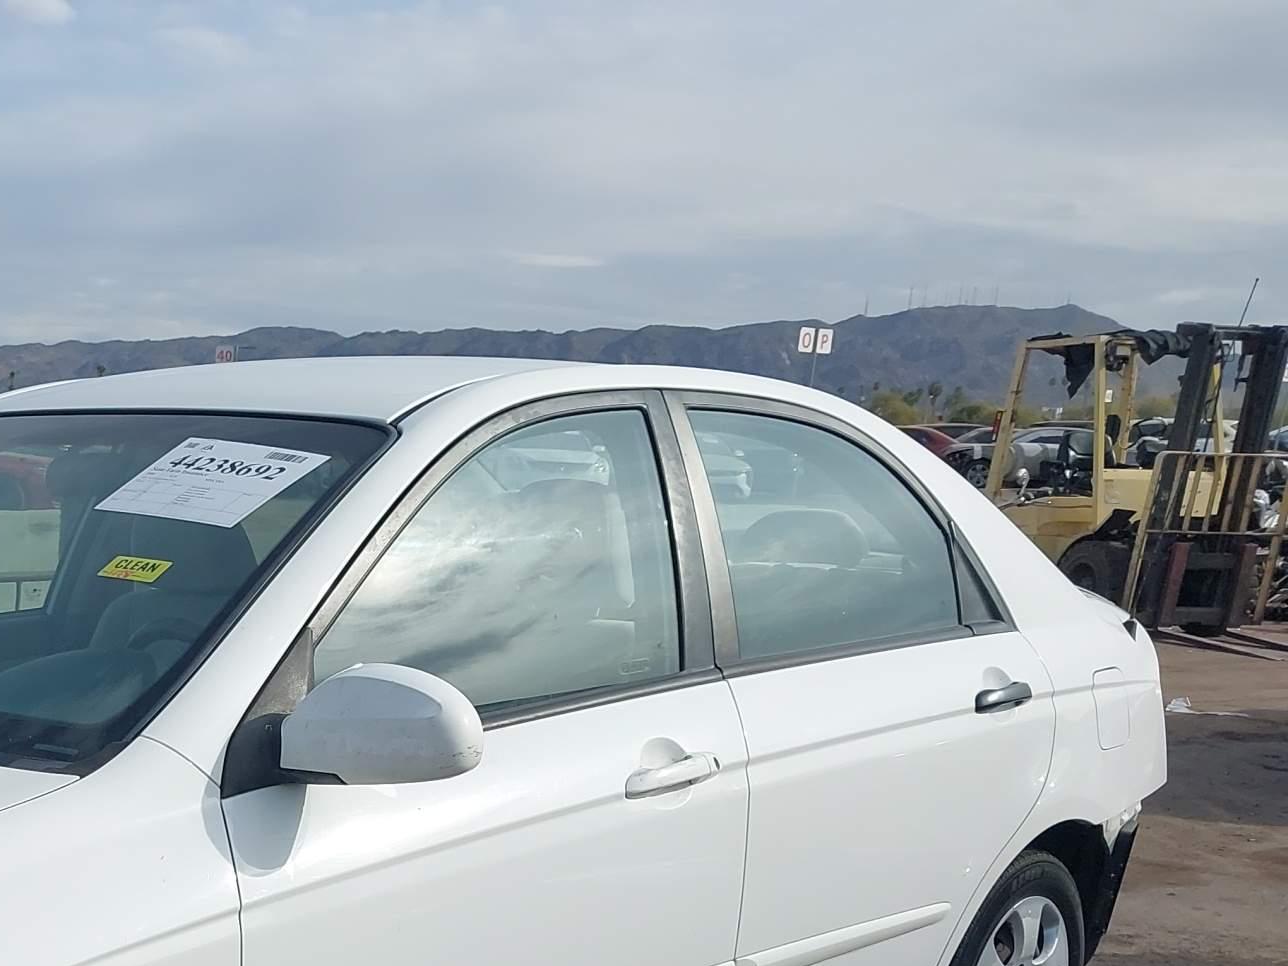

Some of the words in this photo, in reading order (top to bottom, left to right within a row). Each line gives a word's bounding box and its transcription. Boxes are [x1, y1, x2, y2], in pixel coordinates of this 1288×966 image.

[820, 333, 830, 351] P
[216, 349, 233, 362] 40
[169, 454, 286, 481] 44238692
[114, 559, 162, 573] CLEAN
